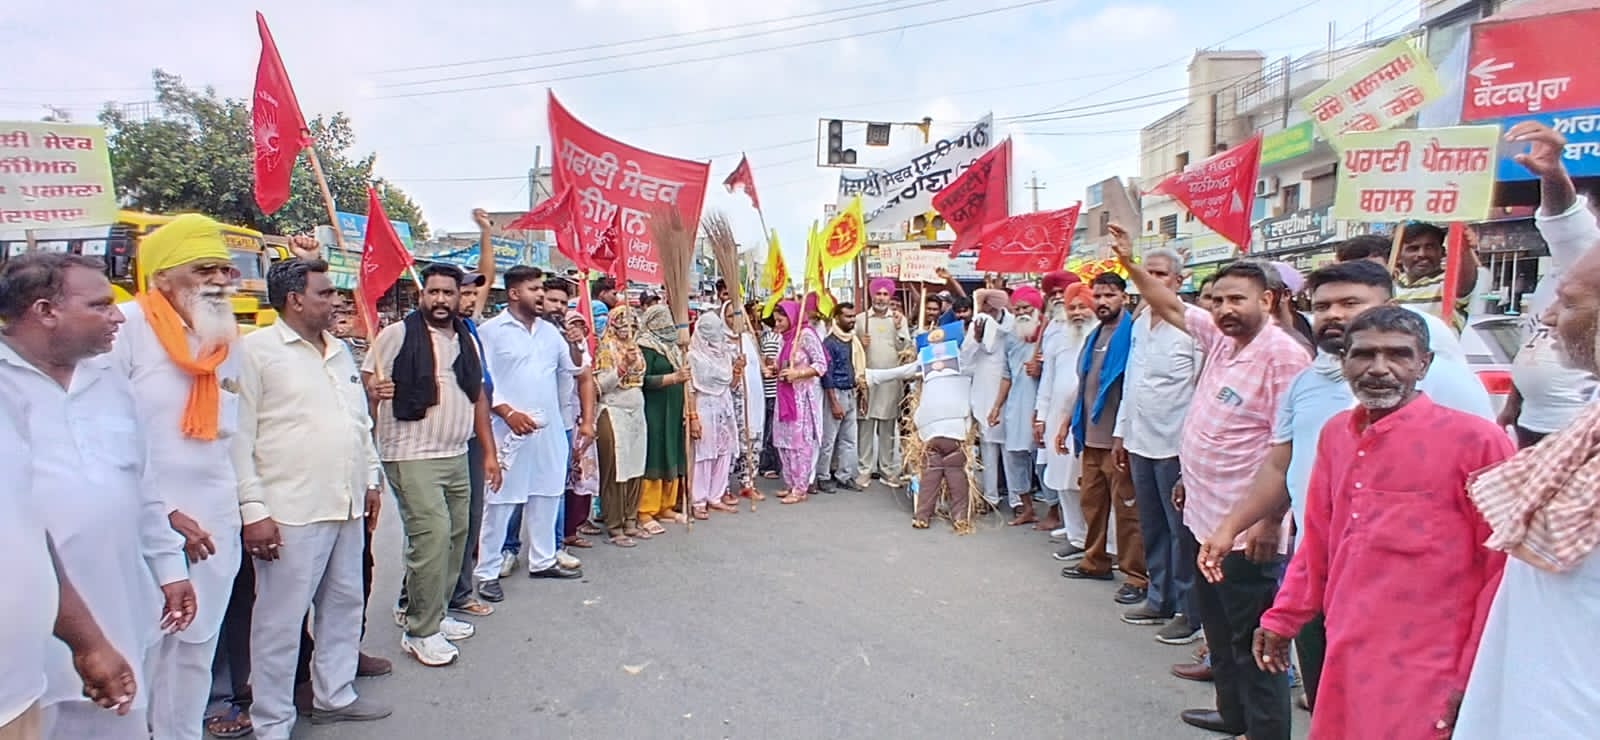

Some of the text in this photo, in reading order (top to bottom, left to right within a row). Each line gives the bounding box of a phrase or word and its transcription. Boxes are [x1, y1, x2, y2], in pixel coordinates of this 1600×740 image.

[1473, 77, 1571, 111] ਕੋਟਕਪੂਰਾ
[43, 131, 93, 150] ਸੇਵਕ
[561, 138, 686, 206] ਸਫਾਈ ਸੇਵਕ
[1346, 140, 1411, 178] ਪੁਰਾਣੀ
[882, 165, 912, 187] ਸੇਵਕ
[1359, 182, 1460, 214] ਬਹਾਲ ਕਰੋ
